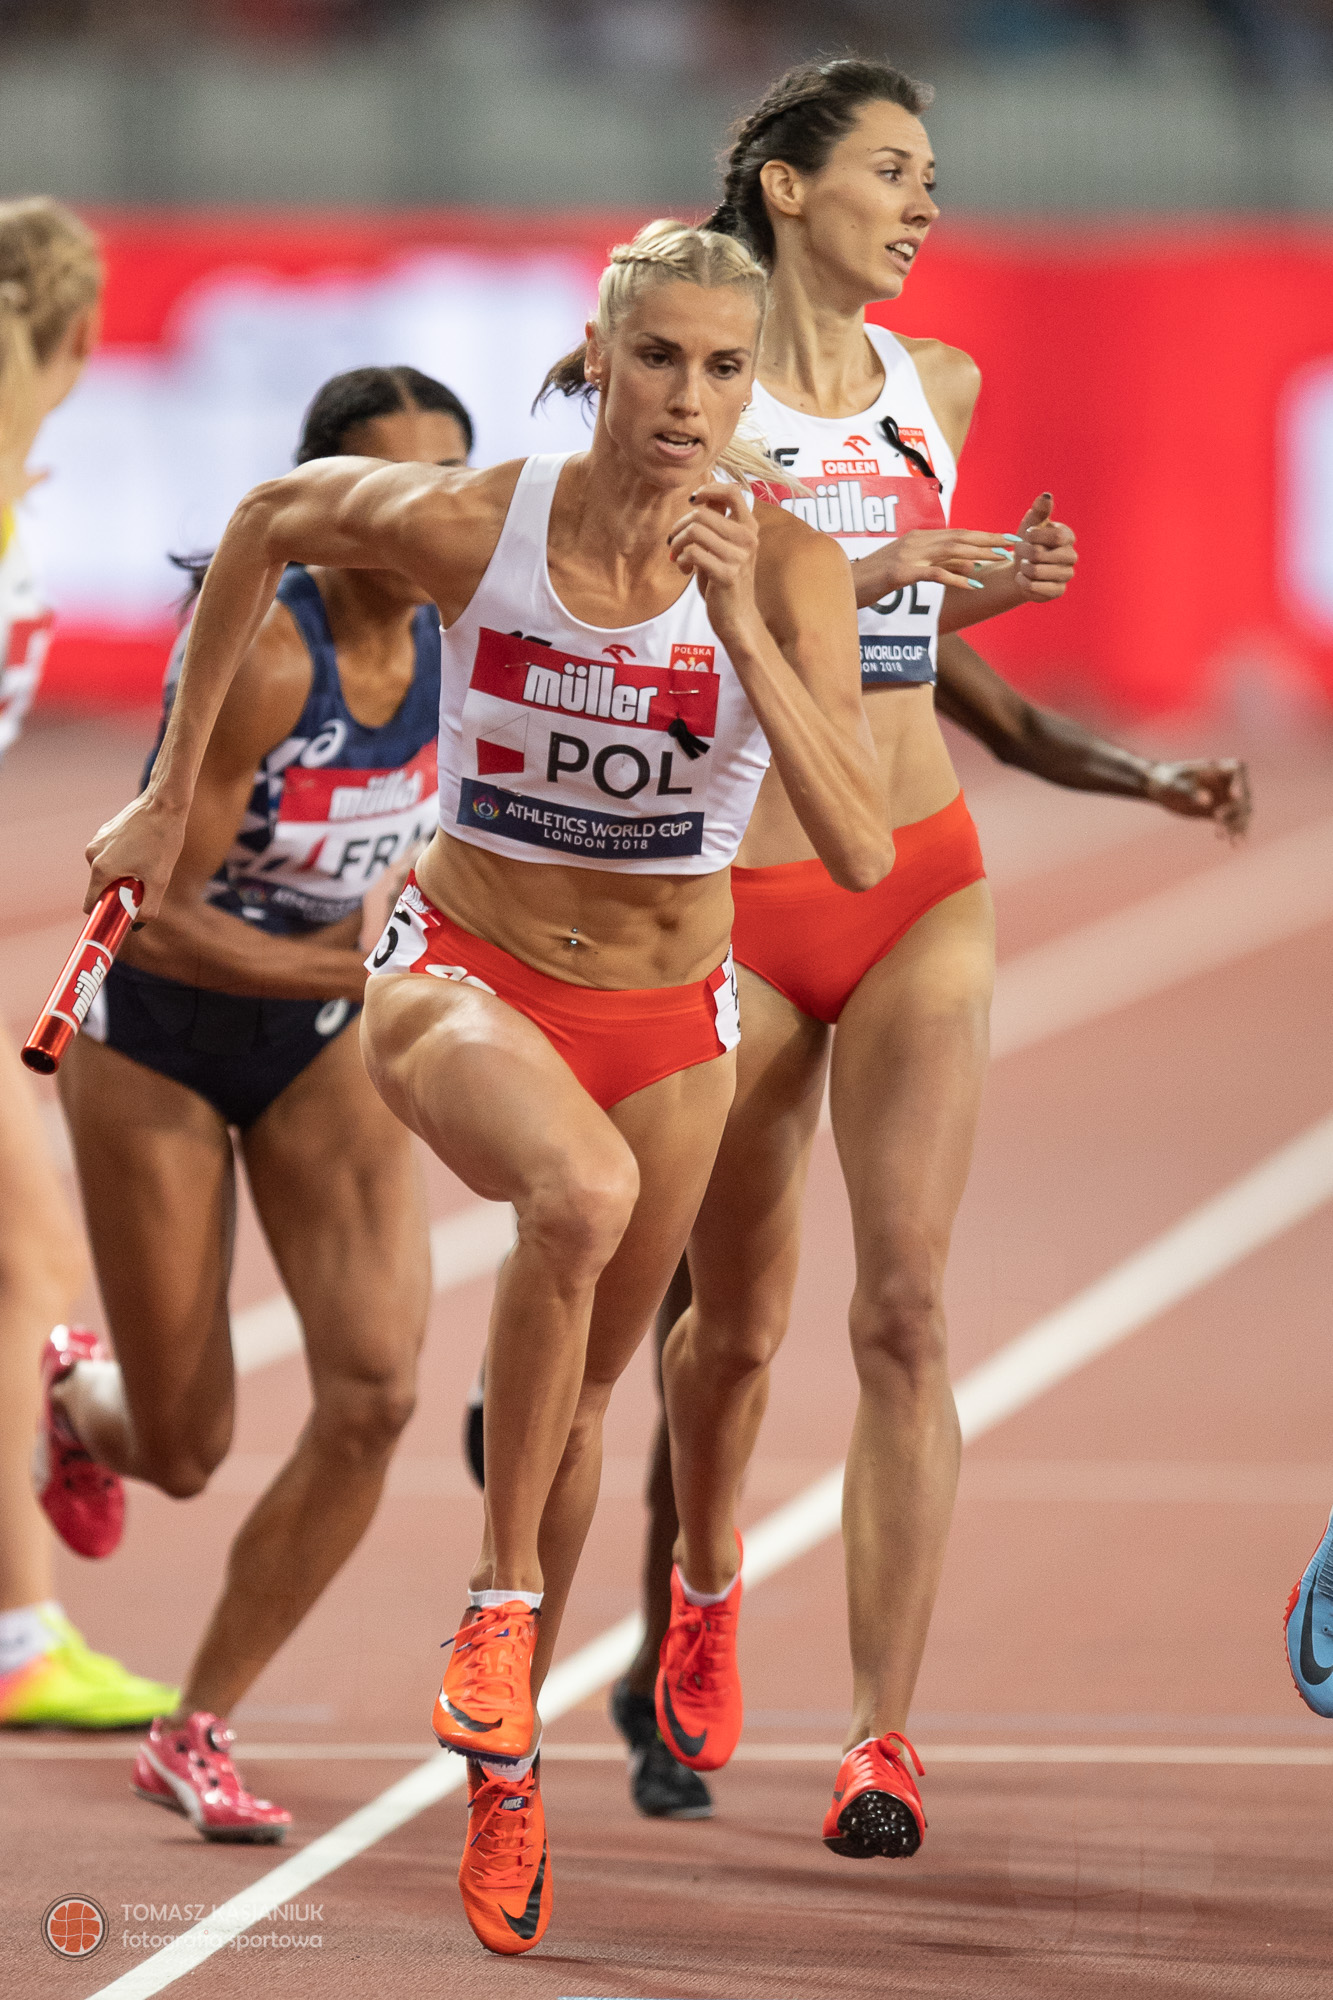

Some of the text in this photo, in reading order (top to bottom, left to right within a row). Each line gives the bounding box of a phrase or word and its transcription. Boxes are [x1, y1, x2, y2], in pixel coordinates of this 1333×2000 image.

[824, 461, 878, 475] ORLEN
[780, 480, 899, 533] müller
[674, 645, 712, 656] POLSKA
[864, 645, 901, 661] WORLD
[879, 661, 903, 673] 2018
[522, 662, 658, 724] müller
[547, 731, 692, 800] POL
[505, 802, 693, 838] ATHLETICS WORLD CUP
[544, 828, 648, 850] LONDON 2018
[501, 1797, 523, 1810] NIKE
